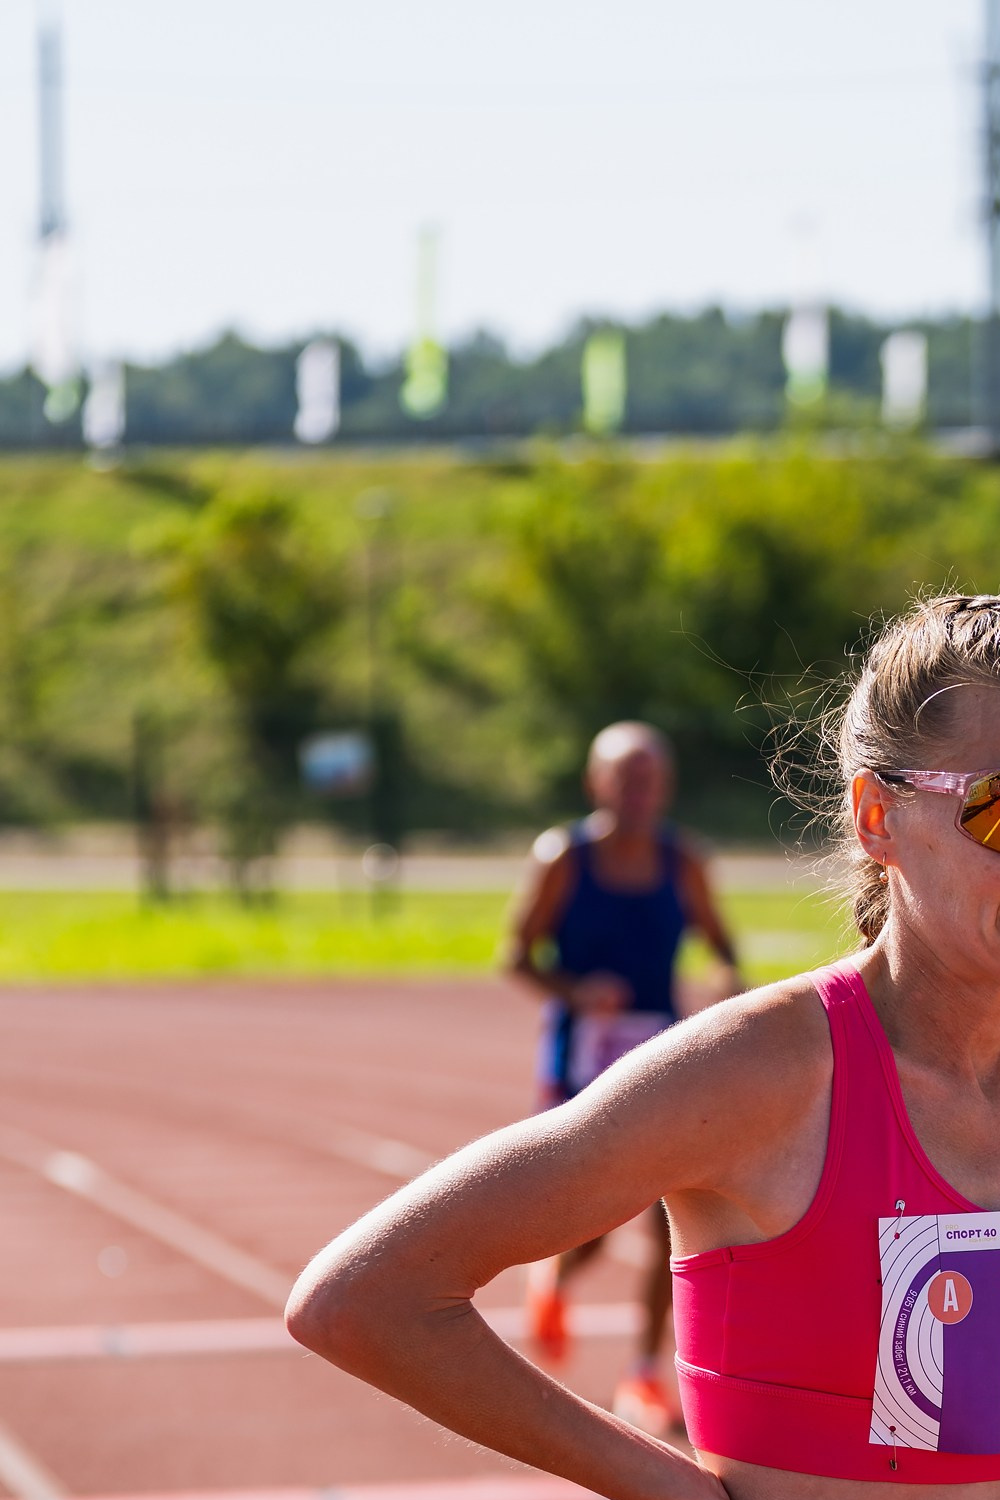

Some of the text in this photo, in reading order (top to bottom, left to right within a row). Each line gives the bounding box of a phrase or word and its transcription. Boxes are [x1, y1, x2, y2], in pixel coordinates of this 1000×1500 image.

[946, 1229, 982, 1239] СПОРТ
[983, 1228, 997, 1238] 40
[894, 1340, 905, 1362] забег
